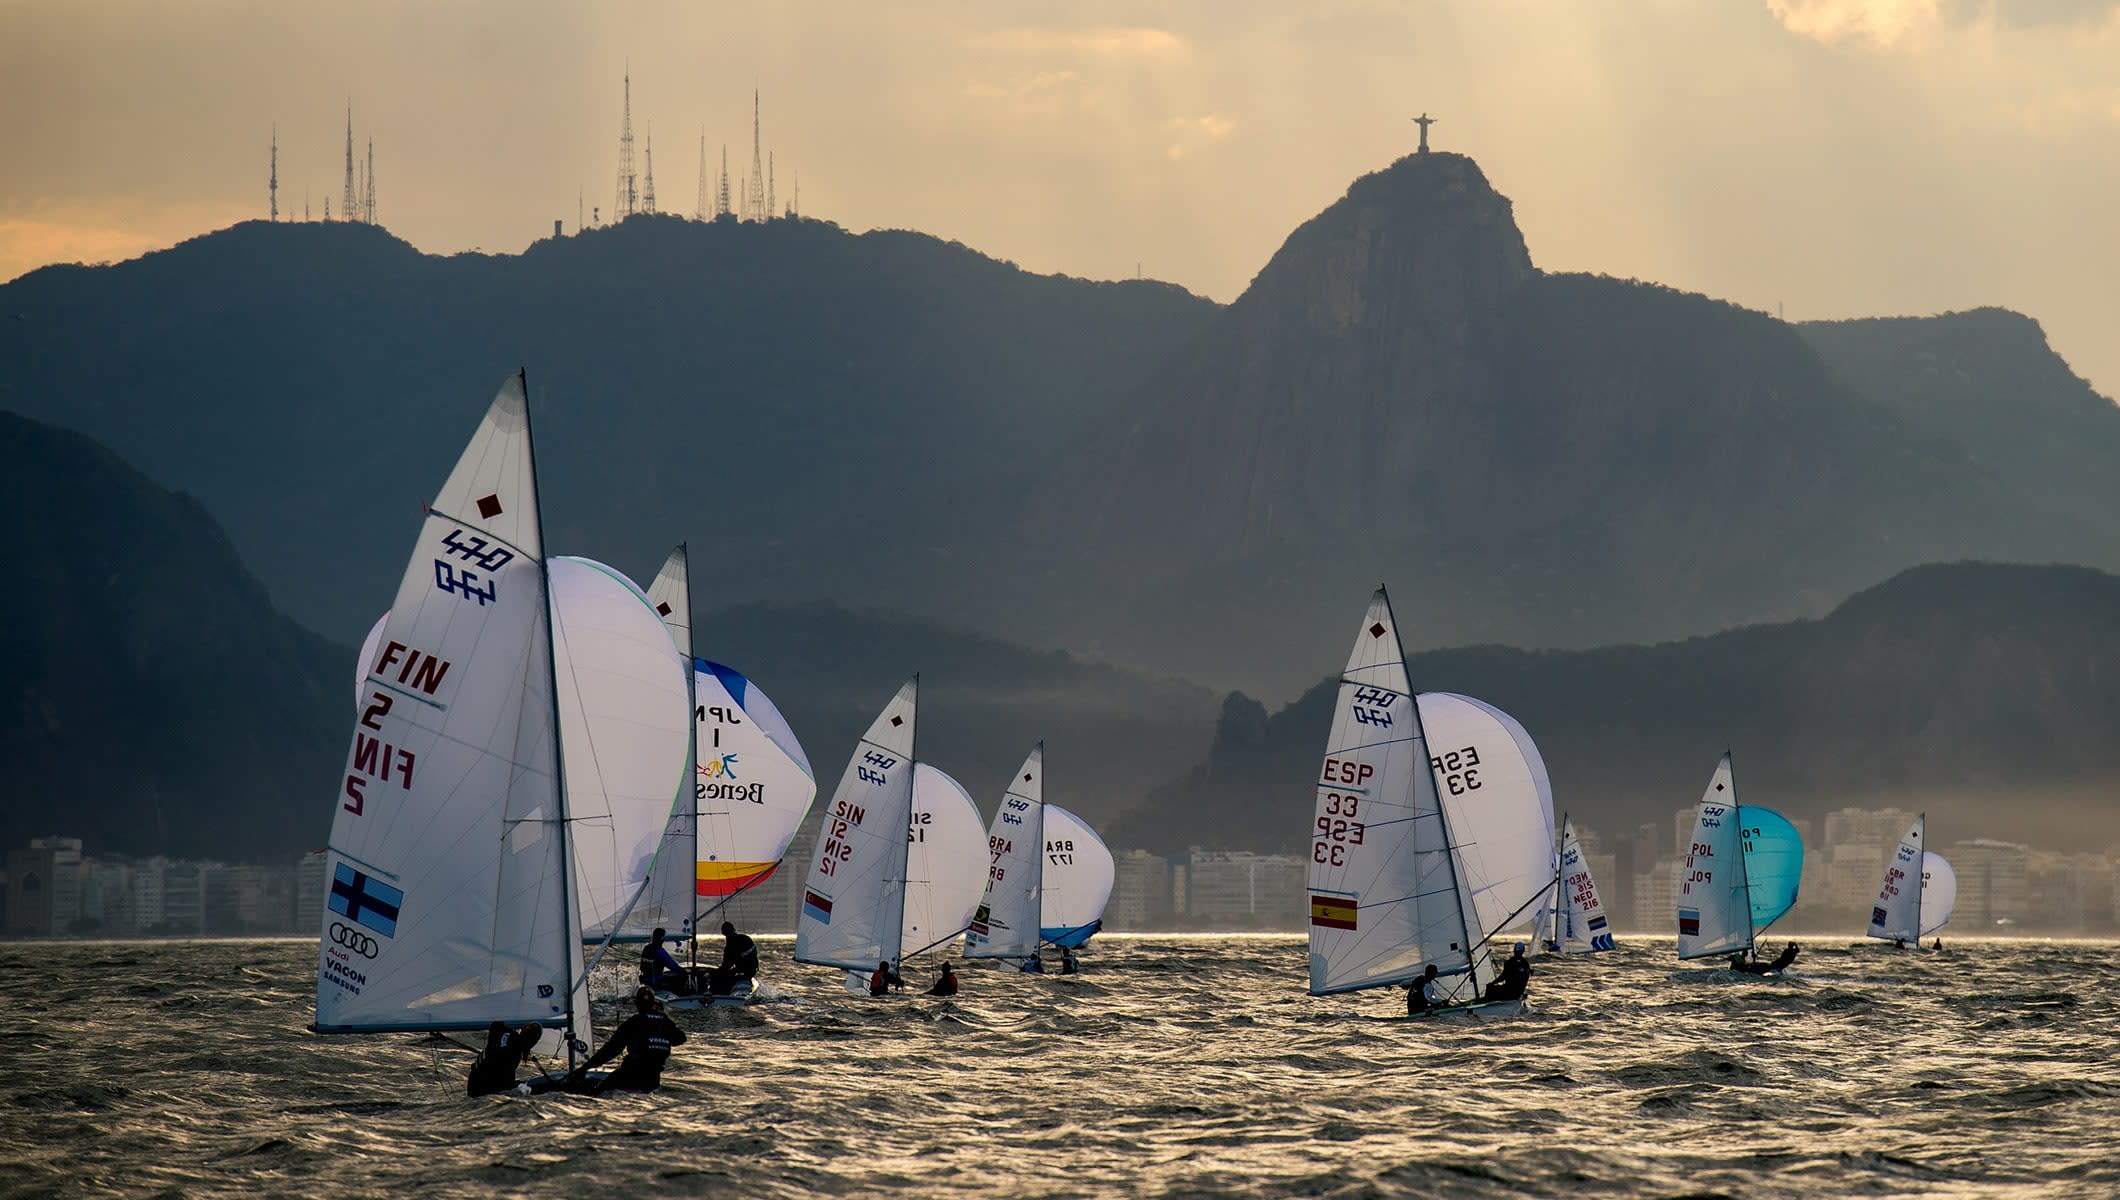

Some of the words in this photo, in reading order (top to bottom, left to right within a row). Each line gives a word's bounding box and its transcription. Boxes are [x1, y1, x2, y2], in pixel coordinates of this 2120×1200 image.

[441, 529, 514, 572] 470
[375, 640, 450, 695] FIN
[1354, 687, 1398, 708] 470
[361, 691, 393, 731] 2
[864, 751, 896, 769] 470
[1323, 759, 1374, 785] ESP
[836, 801, 865, 825] SIN
[1007, 799, 1029, 811] 470
[1326, 793, 1358, 818] 33
[1704, 807, 1725, 817] 470
[831, 819, 847, 839] 12
[989, 836, 1012, 853] BRA
[1692, 843, 1714, 856] POL
[1686, 855, 1694, 868] 11
[1889, 867, 1905, 880] GBR
[1573, 890, 1592, 904] NED
[1583, 898, 1599, 911] 216
[328, 946, 349, 961] Audi
[326, 957, 366, 985] VACON
[324, 971, 360, 995] SAMSUNG
